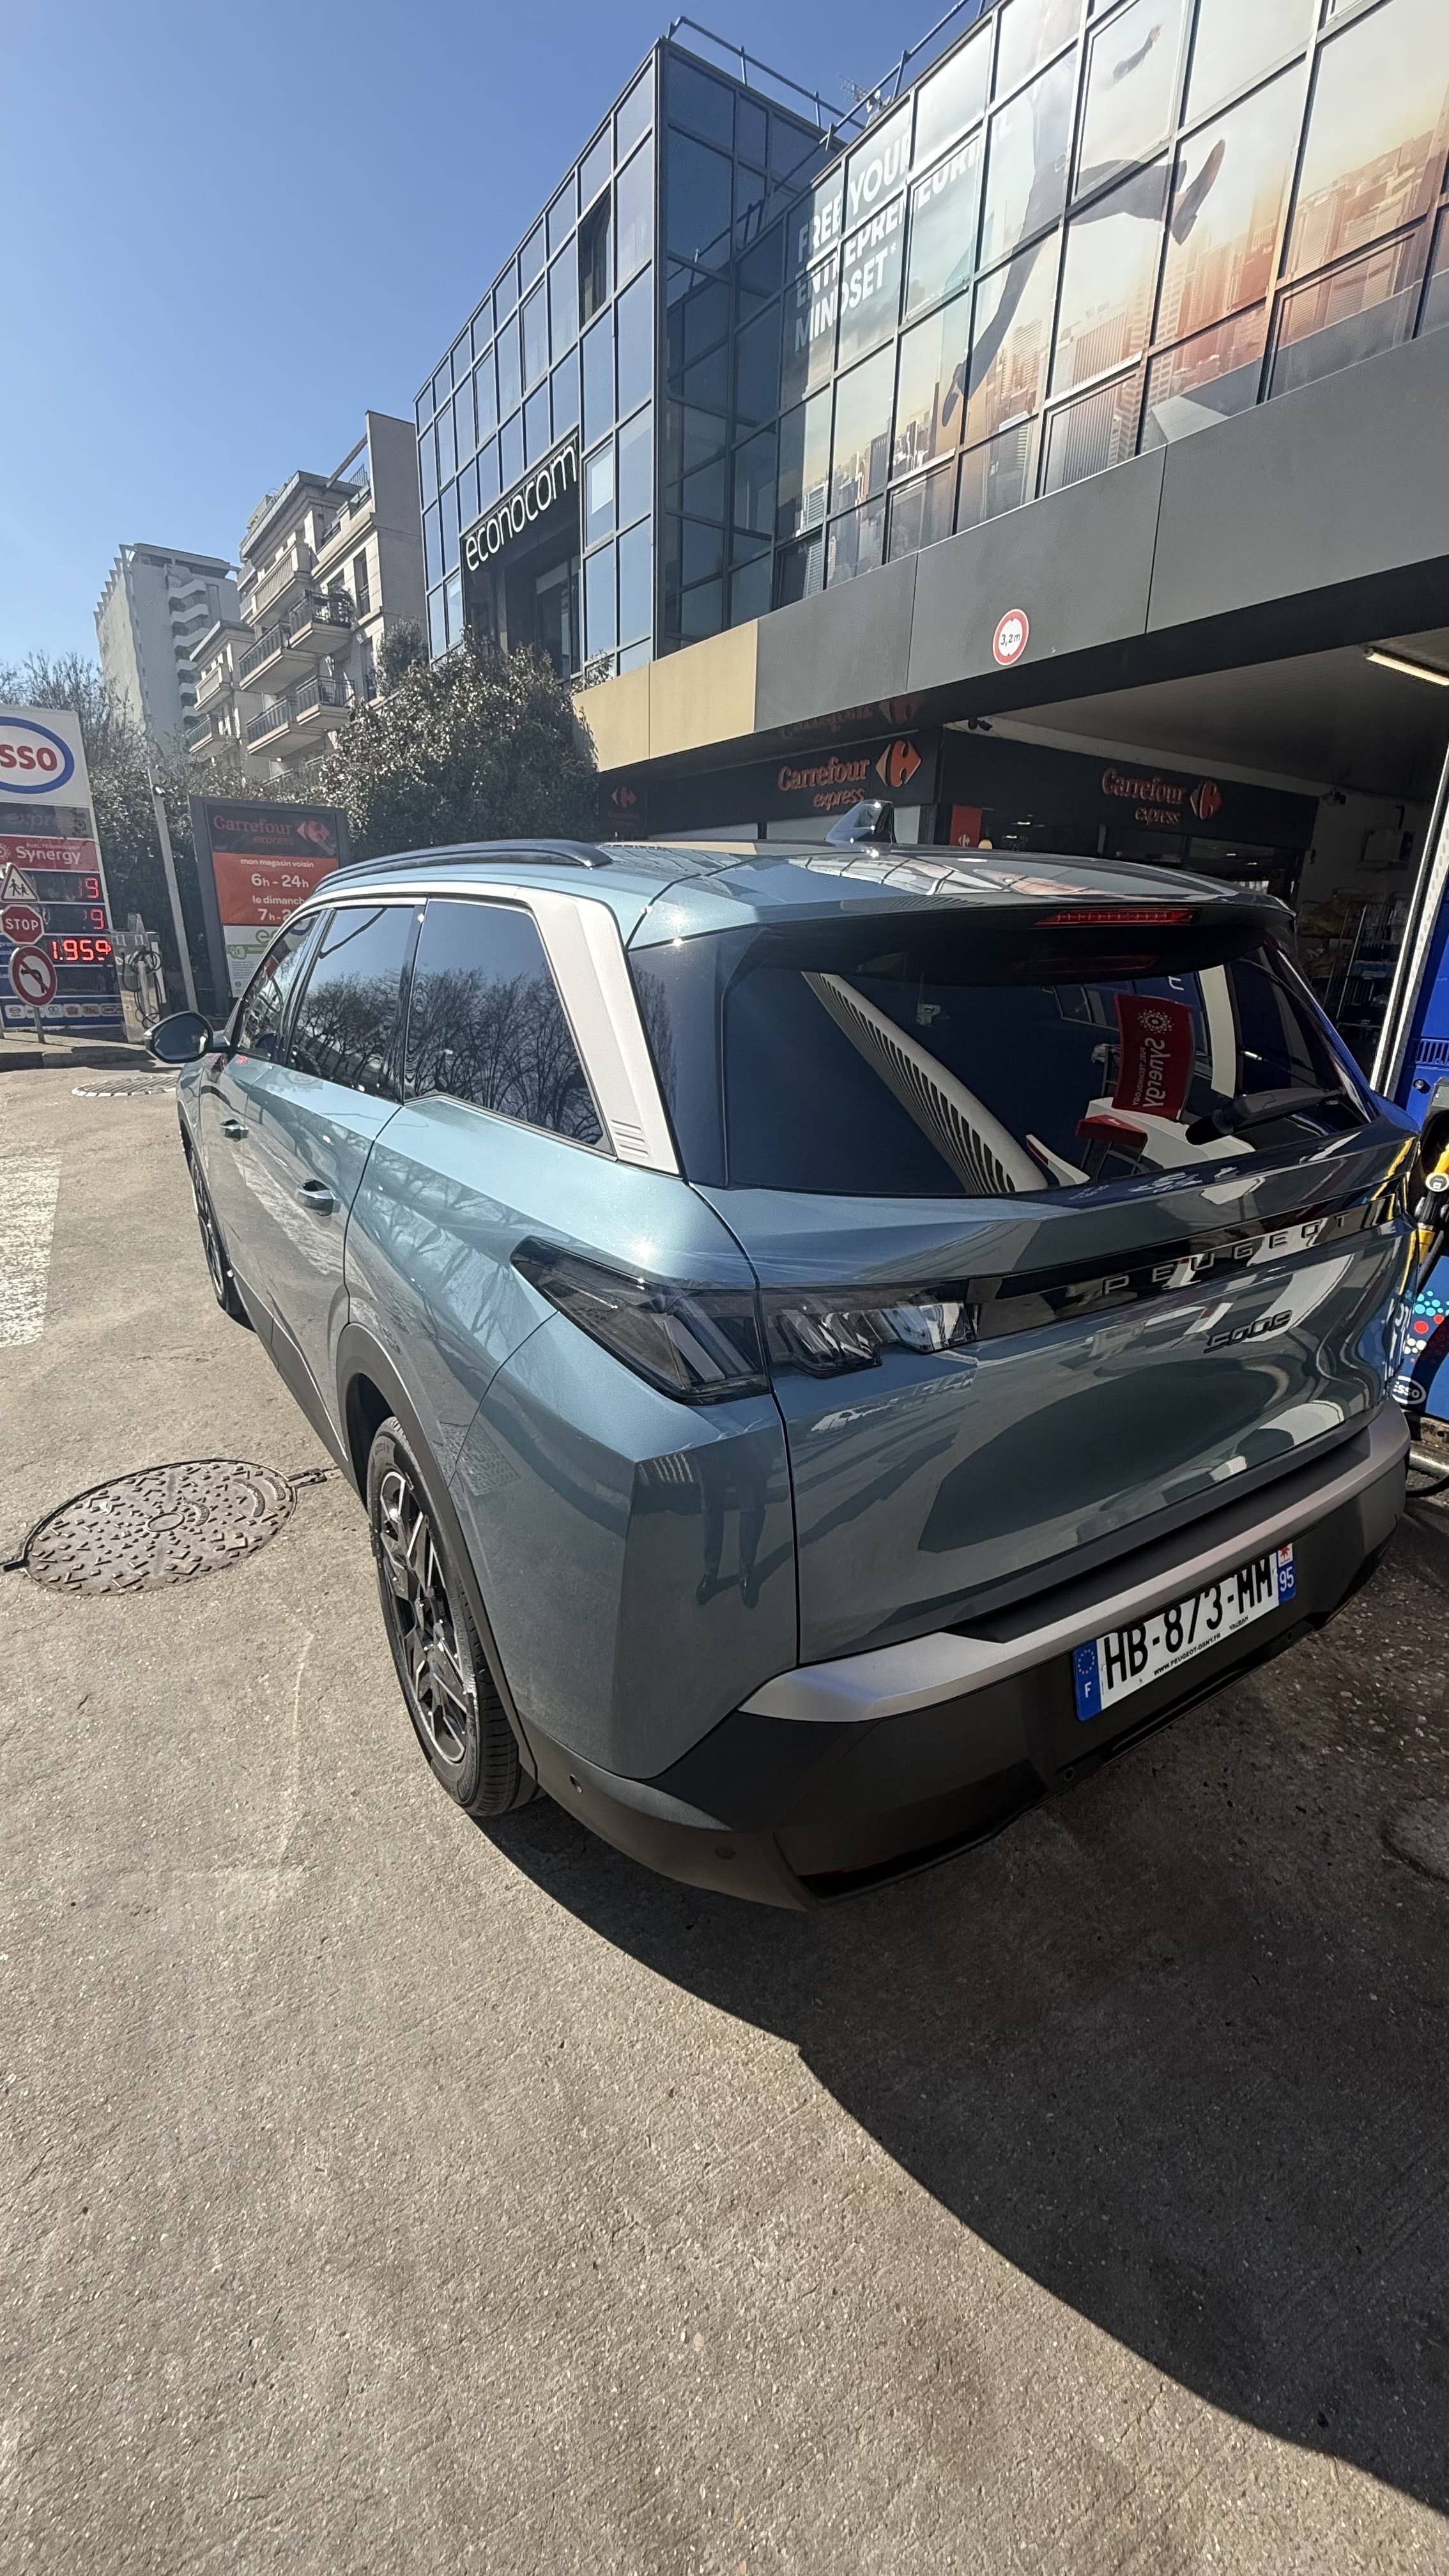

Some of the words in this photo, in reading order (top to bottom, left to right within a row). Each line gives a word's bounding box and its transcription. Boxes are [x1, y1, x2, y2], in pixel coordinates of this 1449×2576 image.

[799, 190, 843, 264] FREE
[466, 446, 576, 571] econocom
[0, 744, 57, 771] SSO
[778, 756, 870, 791] Carrefour
[1102, 767, 1186, 804] Carrefour
[813, 787, 865, 811] express
[213, 815, 292, 834] Carrefour
[1135, 807, 1181, 825] express
[252, 835, 295, 846] express
[16, 845, 80, 865] Synergy
[259, 860, 291, 868] magasin
[263, 896, 307, 905] dimanch
[5, 919, 39, 930] STOP
[51, 939, 109, 961] 1.959
[1101, 1215, 1350, 1295] PEUGEOT
[1204, 1310, 1293, 1354] 5008
[1280, 1566, 1294, 1592] 95
[1085, 1682, 1091, 1698] F
